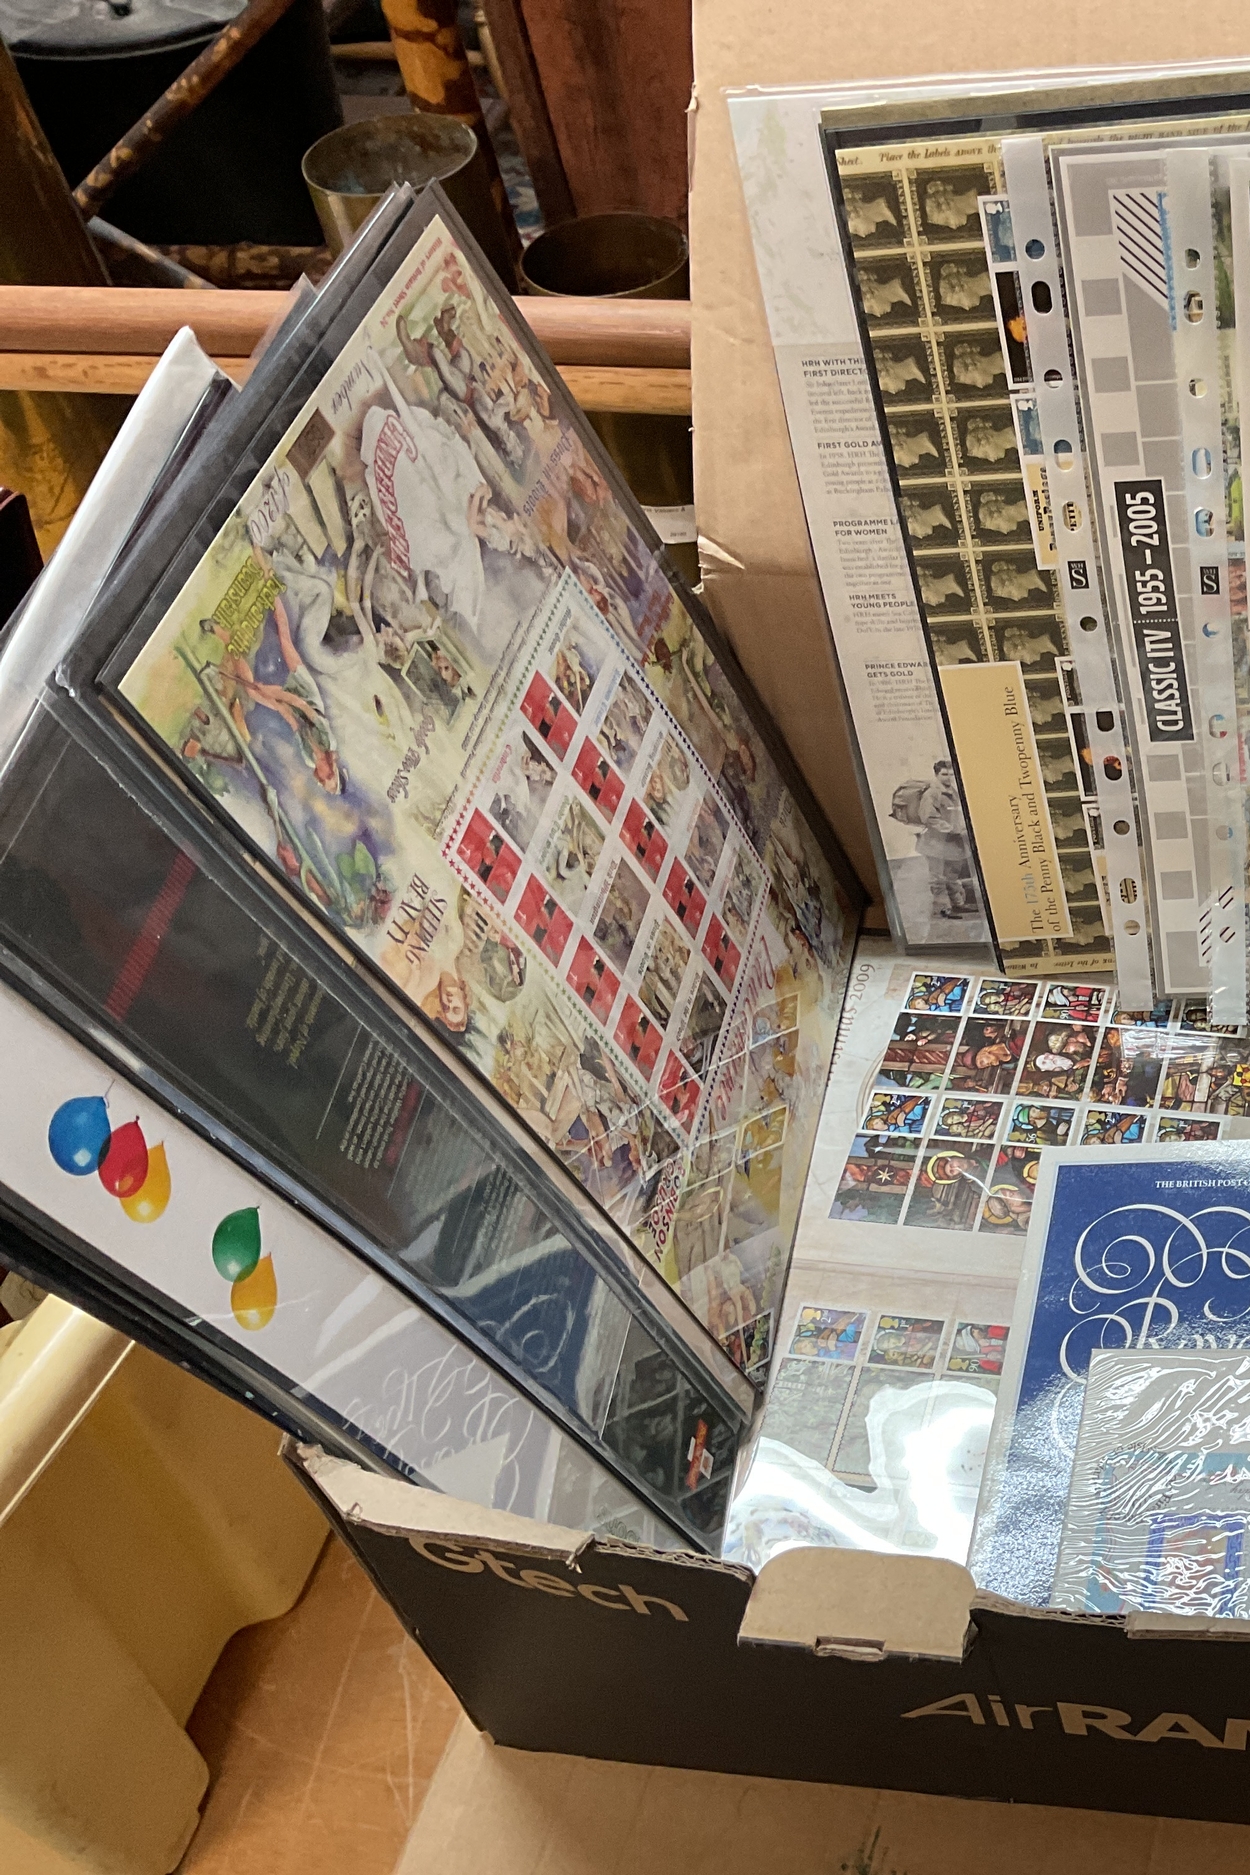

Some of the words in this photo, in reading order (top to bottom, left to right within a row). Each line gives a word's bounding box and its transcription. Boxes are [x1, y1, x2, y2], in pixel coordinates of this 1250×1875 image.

[331, 344, 376, 416] Number
[547, 433, 575, 467] Puss
[844, 441, 868, 449] GOLD
[540, 463, 557, 480] in
[243, 488, 290, 542] 1200
[518, 478, 551, 518] Boots
[833, 519, 888, 527] PROGRAMME
[854, 528, 887, 536] WOMEN
[255, 569, 286, 611] Jack
[1143, 629, 1172, 656] ITV
[1004, 686, 1018, 716] Blue
[1155, 659, 1184, 732] CLASSIC
[1016, 720, 1034, 790] Twopenny
[1028, 792, 1039, 816] and
[1008, 794, 1031, 869] Anniversary
[1032, 819, 1046, 854] Black
[1023, 873, 1038, 910] 175th
[1040, 855, 1057, 894] Penny
[384, 873, 430, 948] BEAUTY
[1046, 896, 1058, 914] the
[402, 890, 450, 970] SLEEPING
[1030, 915, 1045, 934] The
[1051, 916, 1062, 932] of
[849, 961, 876, 1003] 2009
[1155, 1179, 1174, 1188] THE
[1175, 1178, 1216, 1188] BRITISH
[1217, 1178, 1242, 1187] POST
[653, 1163, 686, 1262] ROBINSON
[407, 1536, 689, 1624] Gtech
